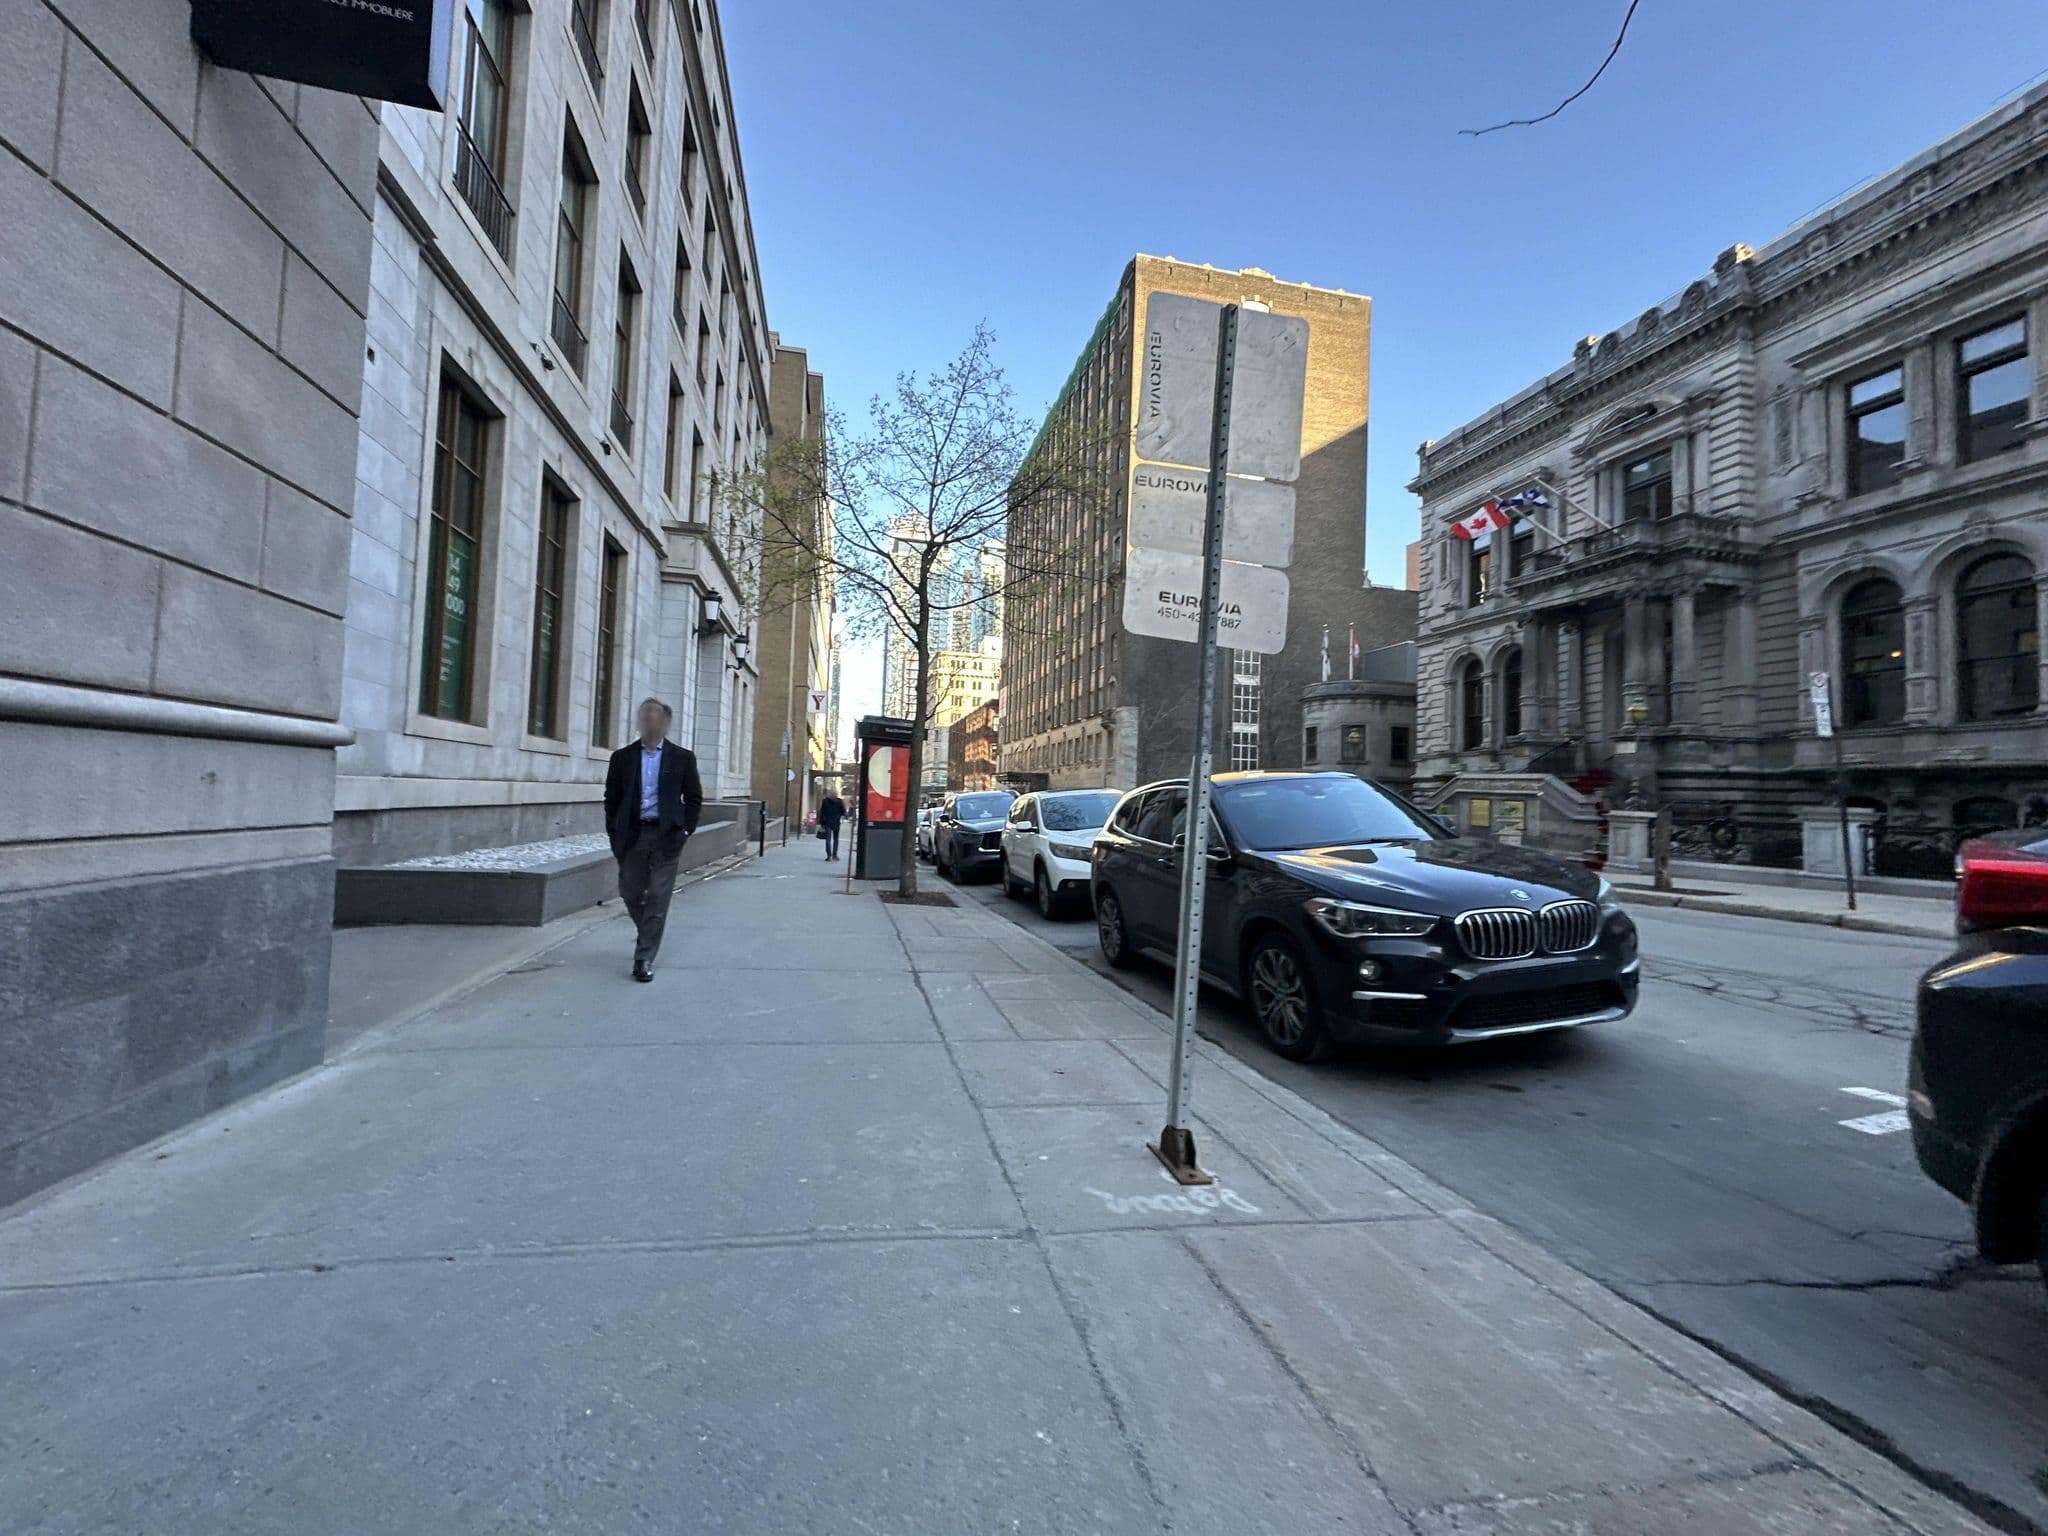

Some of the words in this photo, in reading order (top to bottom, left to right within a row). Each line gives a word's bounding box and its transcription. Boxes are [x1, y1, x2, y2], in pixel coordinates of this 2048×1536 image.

[1150, 331, 1162, 418] EUROVIA
[1135, 475, 1207, 494] EUROVI
[1159, 591, 1242, 615] EURVIA
[811, 694, 825, 710] Y
